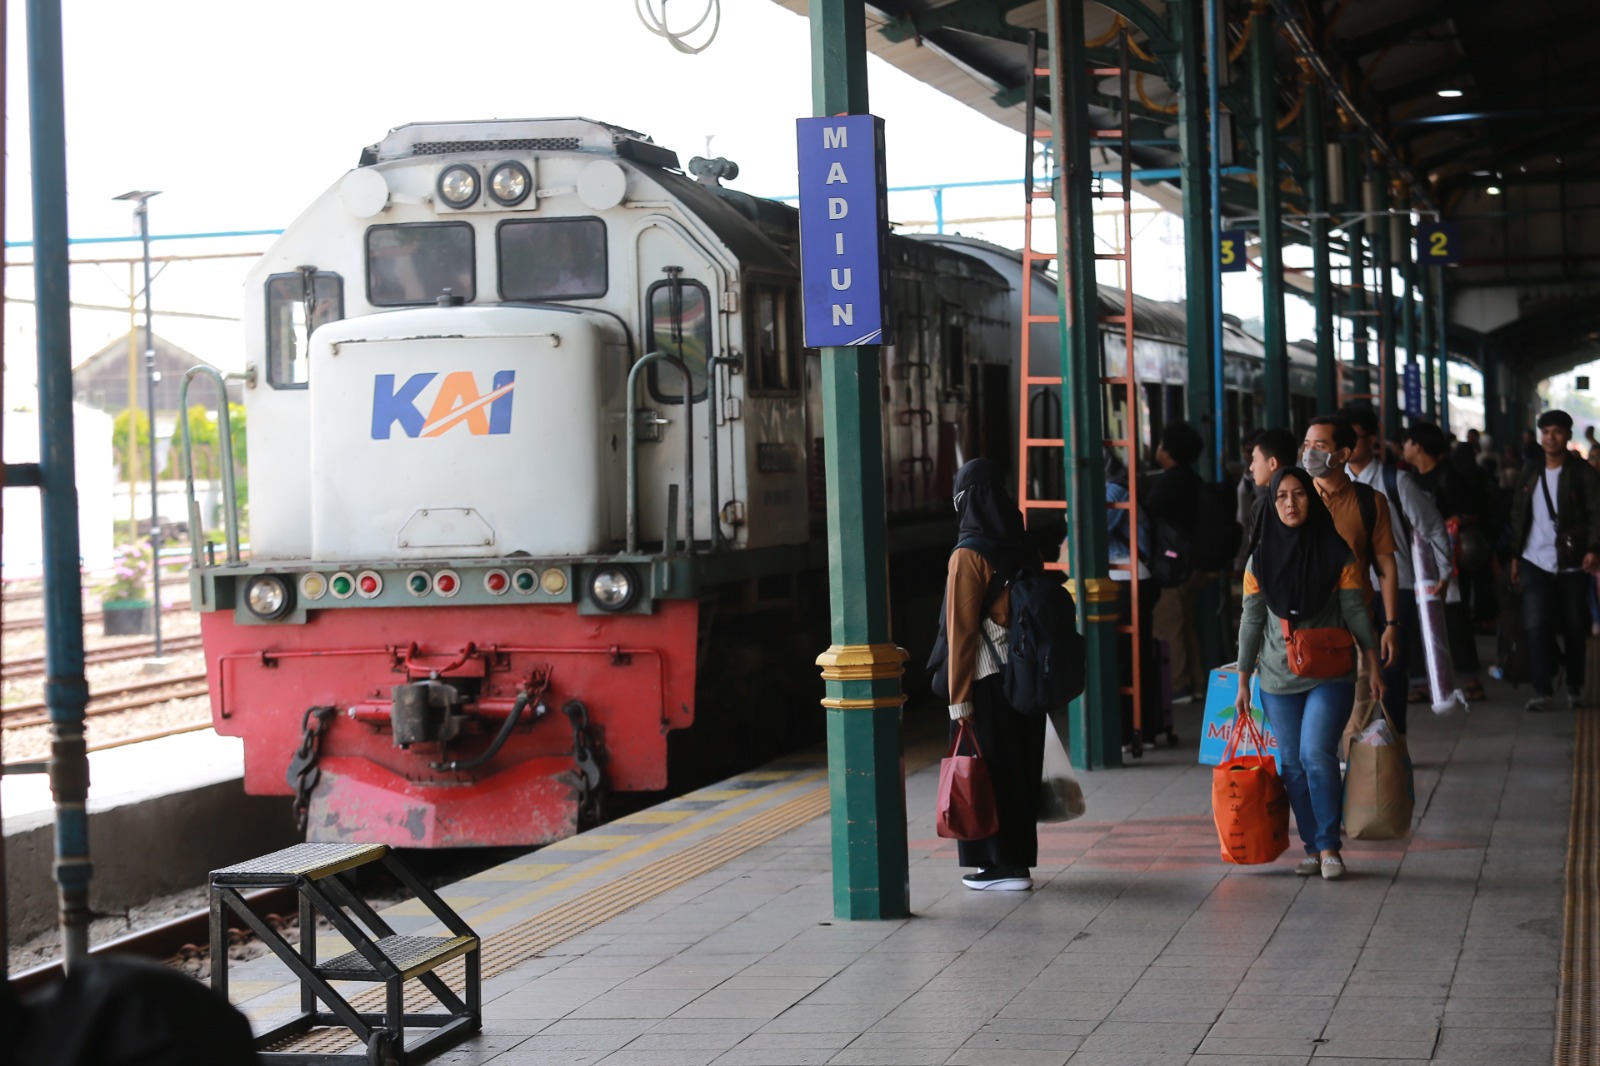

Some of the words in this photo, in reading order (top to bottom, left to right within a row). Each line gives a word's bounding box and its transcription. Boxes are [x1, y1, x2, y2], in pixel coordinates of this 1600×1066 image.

[823, 126, 853, 326] MADIUN
[1429, 232, 1448, 256] 2
[1221, 240, 1235, 265] 3
[370, 369, 516, 440] KAI
